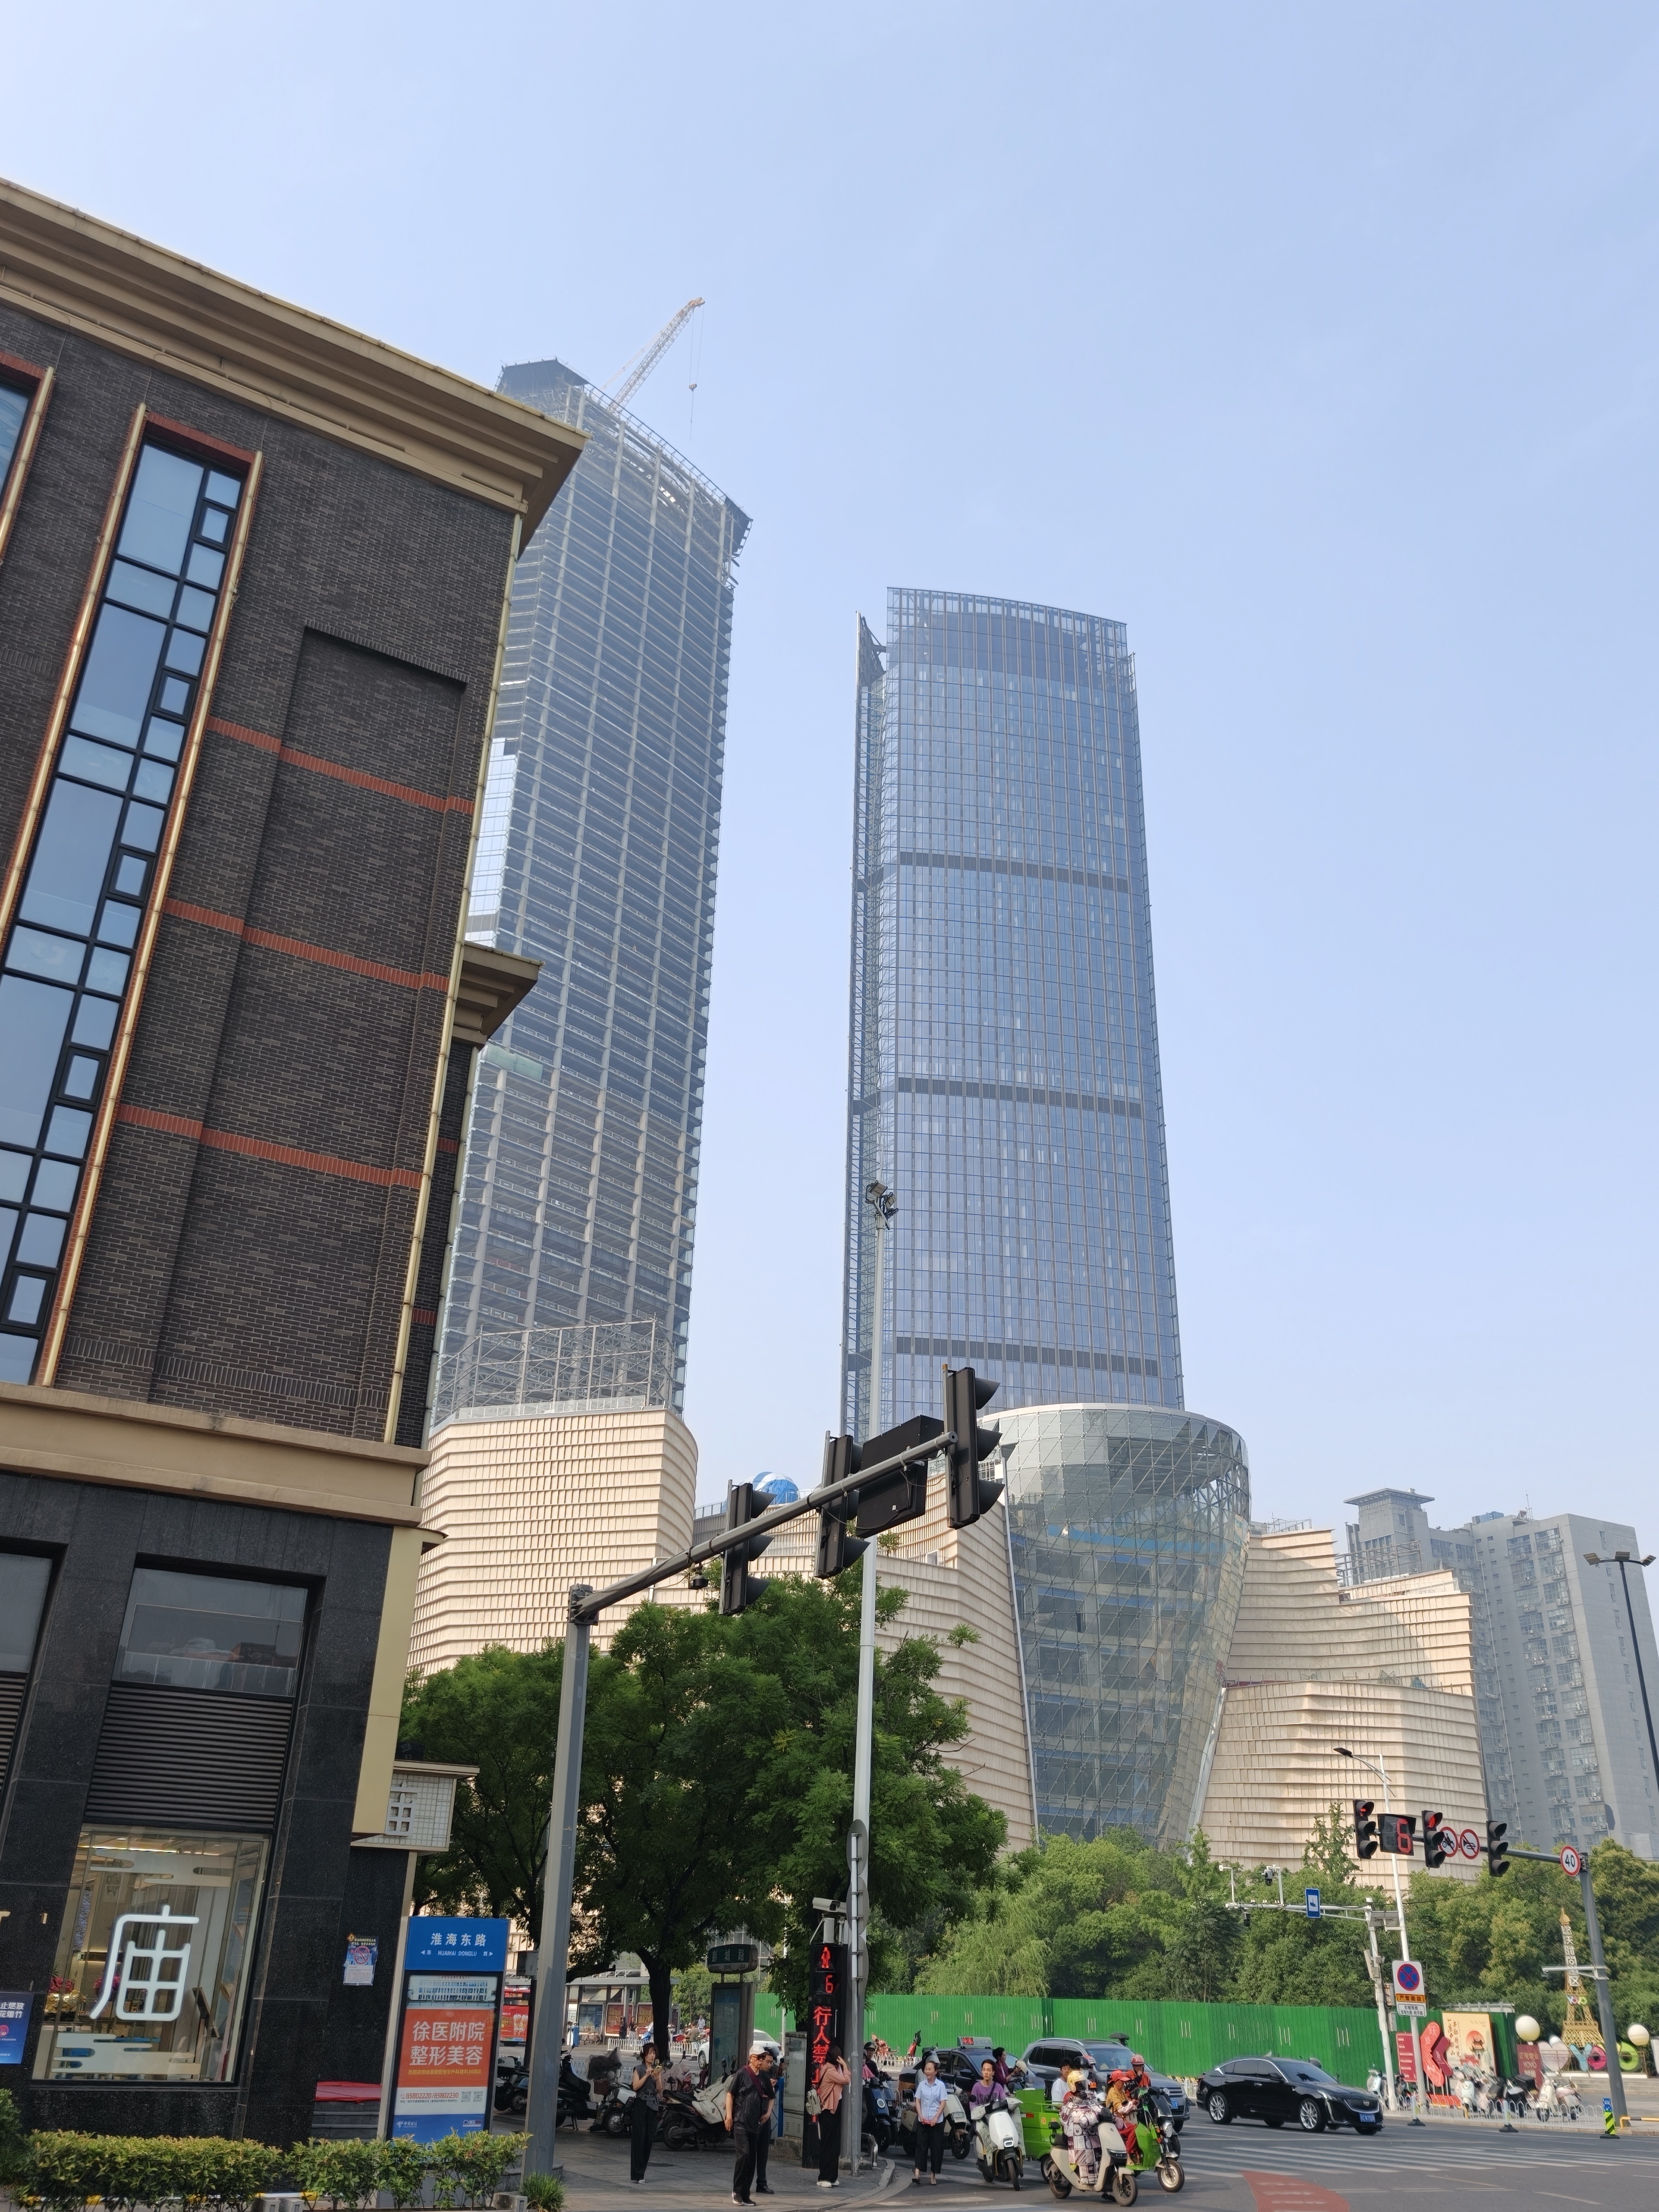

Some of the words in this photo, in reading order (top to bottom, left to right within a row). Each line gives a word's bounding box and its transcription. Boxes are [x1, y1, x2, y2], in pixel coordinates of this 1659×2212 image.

[1397, 1818, 1412, 1853] 6
[1565, 1854, 1576, 1866] 40
[430, 1932, 487, 1947] 淮海东路
[826, 1974, 833, 1993] 6
[413, 2021, 485, 2042] 徐医附院
[409, 2045, 483, 2066] 整形美容
